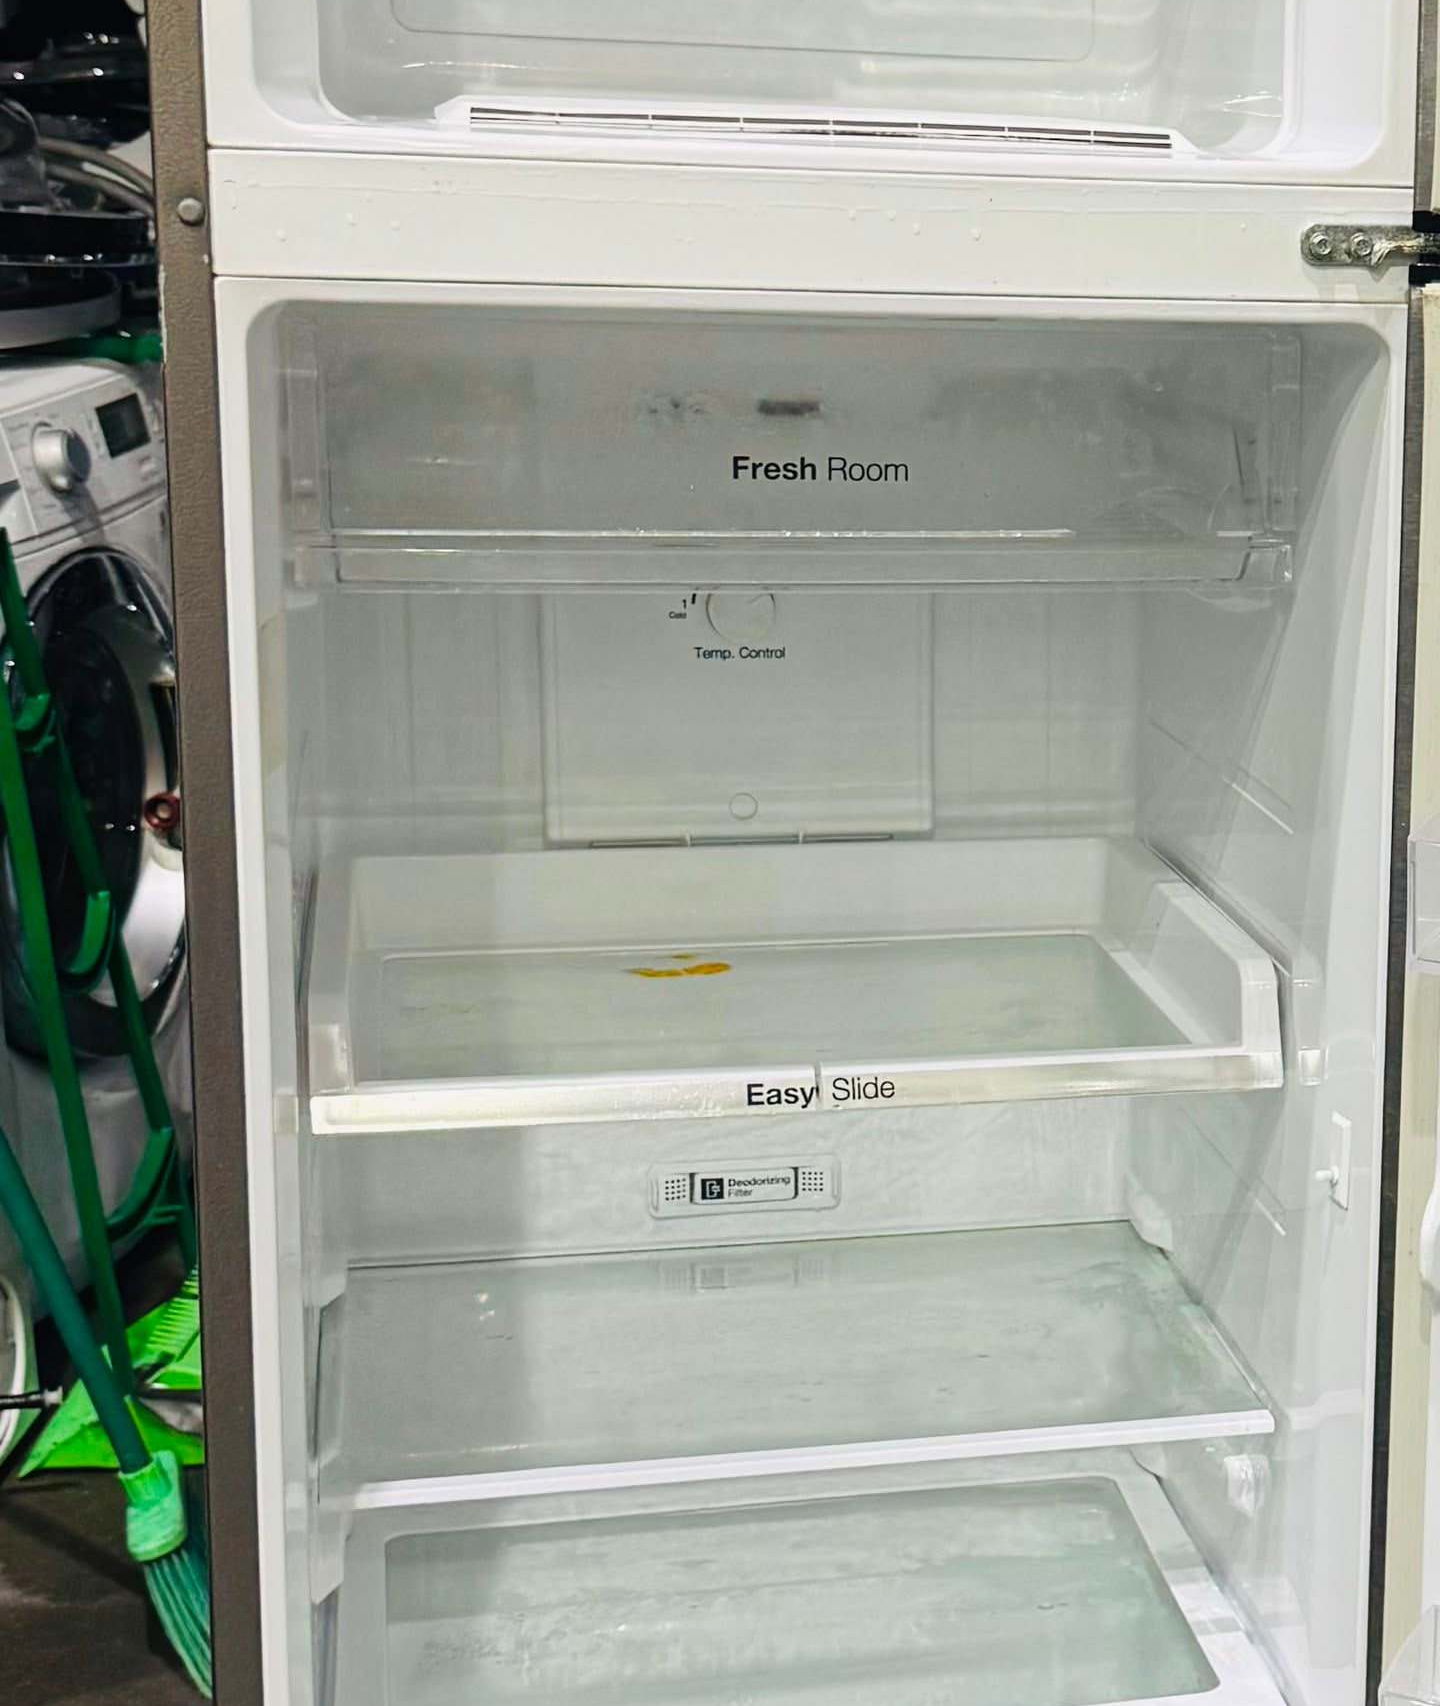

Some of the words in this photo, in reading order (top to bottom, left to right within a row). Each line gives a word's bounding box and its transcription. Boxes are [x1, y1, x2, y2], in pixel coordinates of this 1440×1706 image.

[732, 455, 817, 481] Fresh
[828, 456, 909, 482] Room
[682, 599, 687, 609] 1
[693, 646, 735, 661] Temp.
[739, 646, 786, 660] Control
[746, 1083, 819, 1109] Easy
[832, 1076, 896, 1101] Slide
[728, 1176, 790, 1188] Deodorizing
[728, 1188, 753, 1198] Filter
